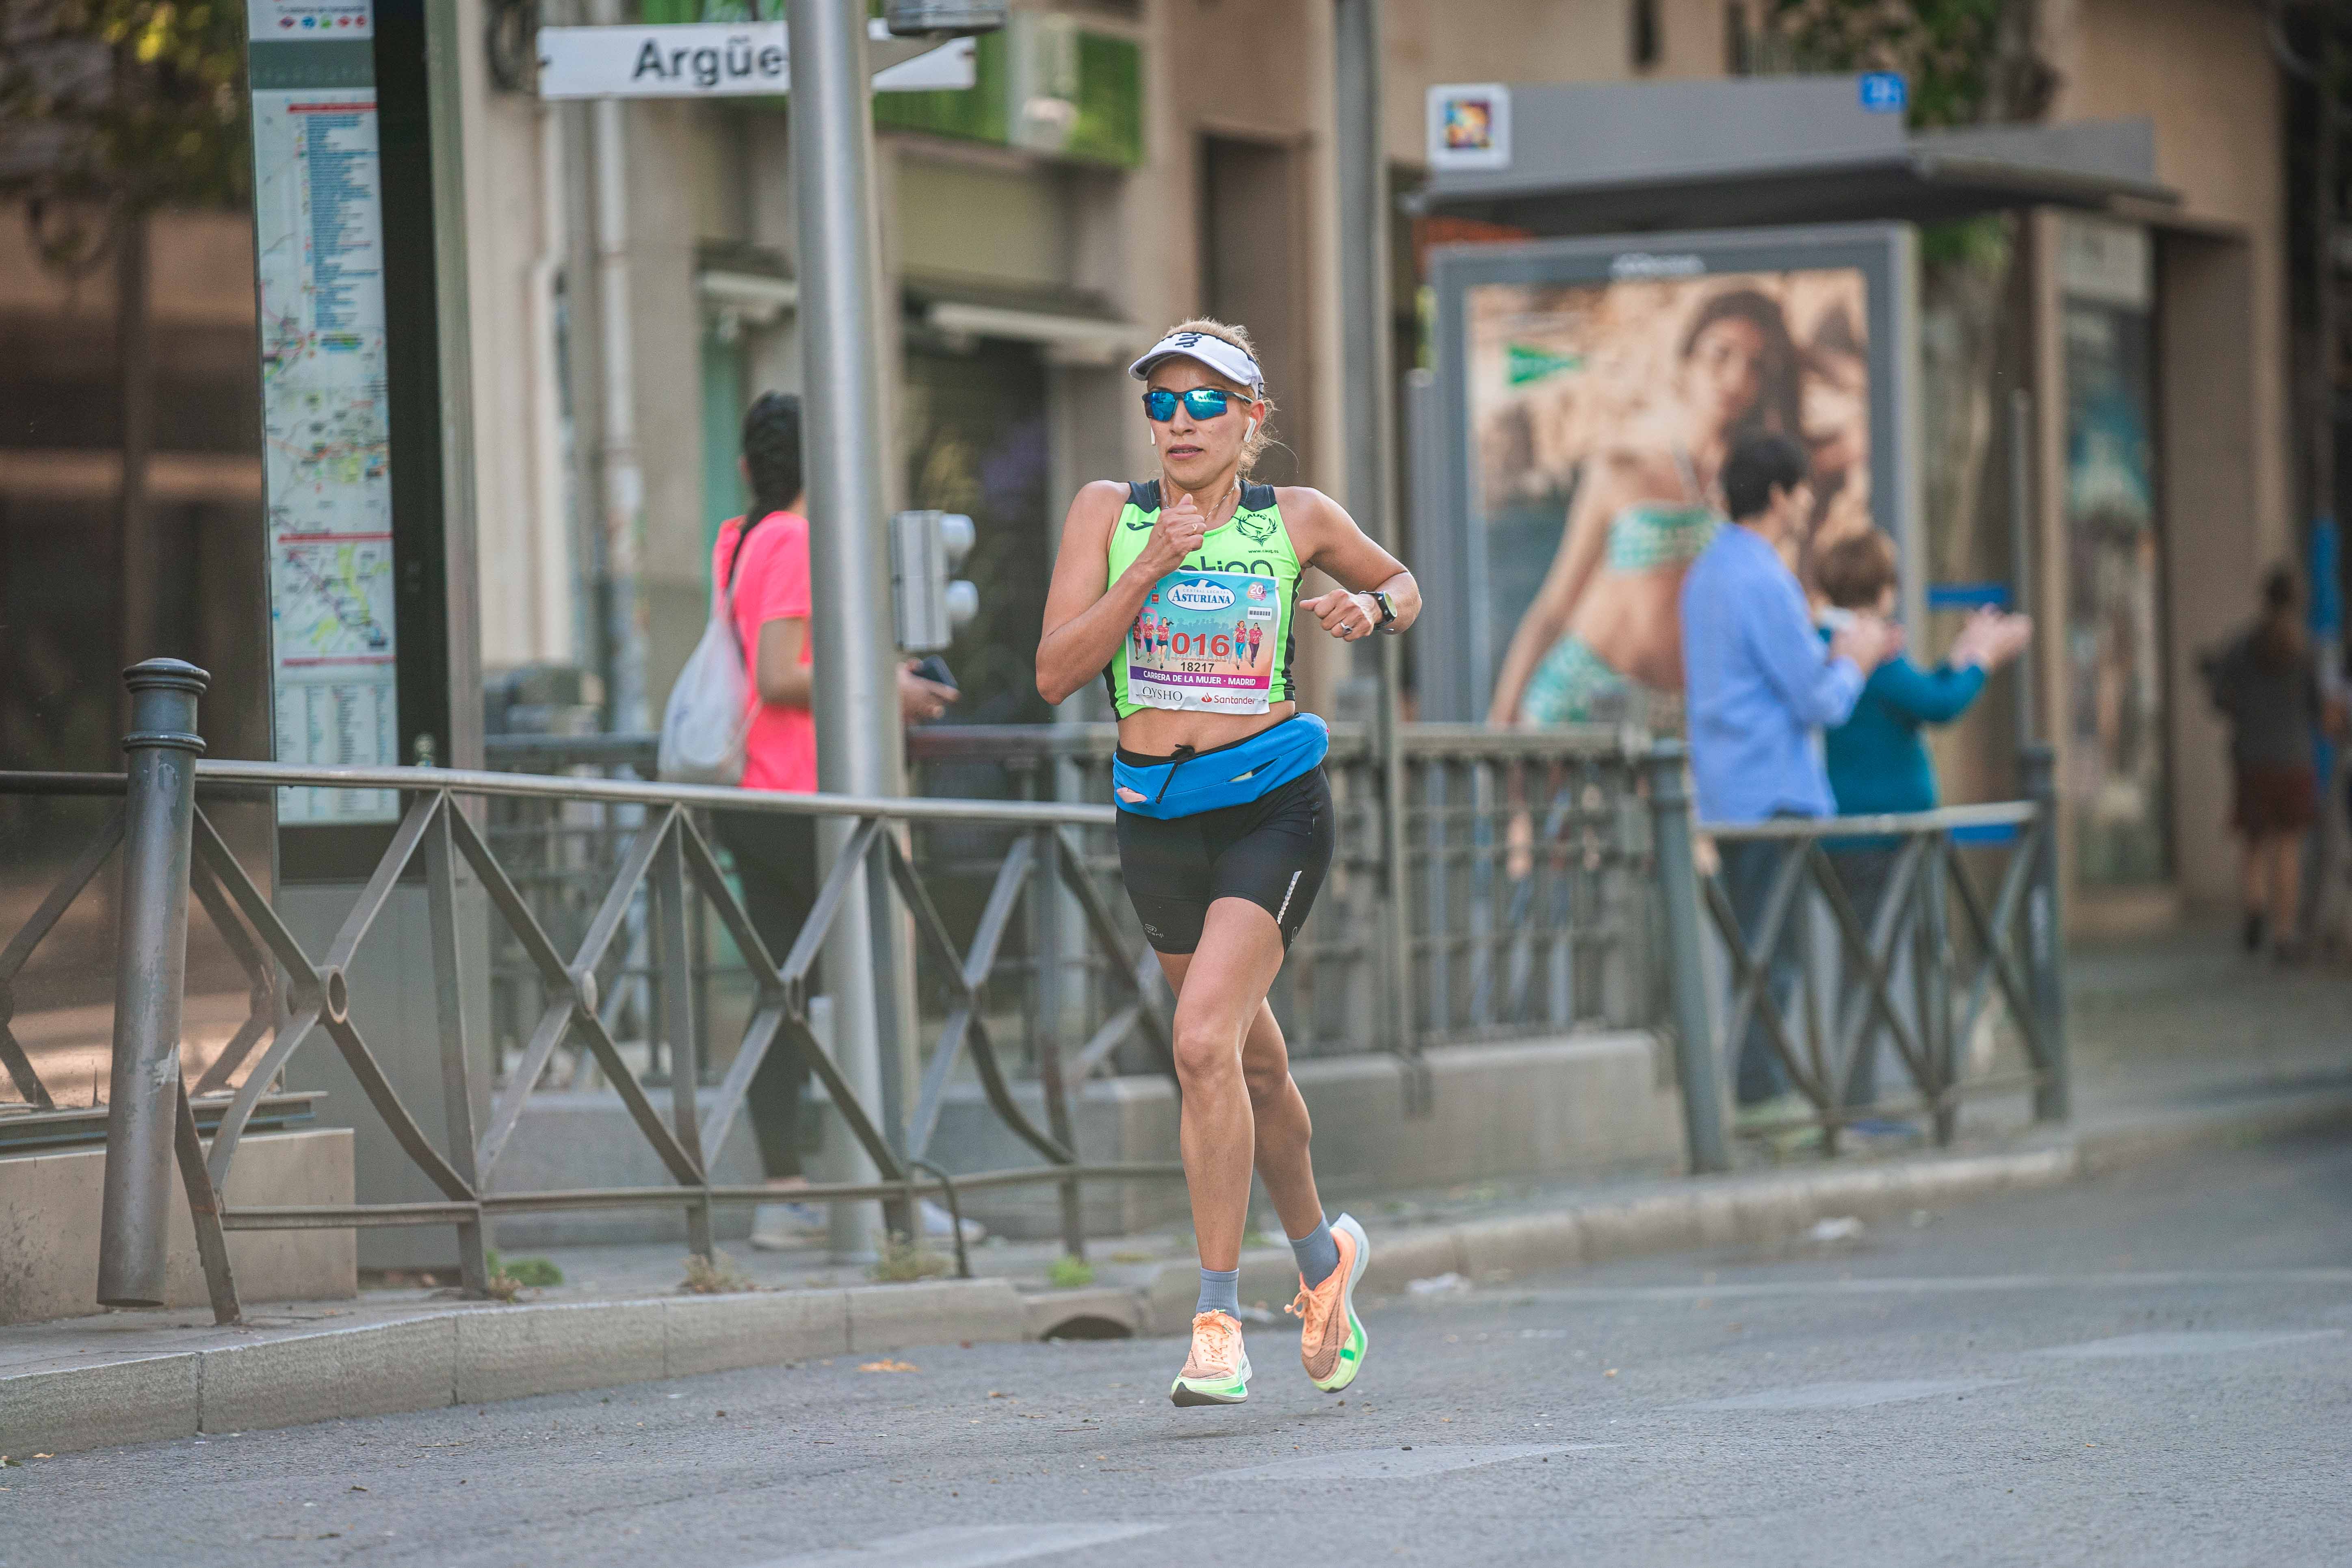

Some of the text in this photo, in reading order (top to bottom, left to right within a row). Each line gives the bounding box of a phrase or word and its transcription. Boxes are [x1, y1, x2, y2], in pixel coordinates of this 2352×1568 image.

[633, 36, 787, 86] Argüe
[1243, 513, 1267, 522] CAUG
[1250, 584, 1263, 594] 20
[1172, 589, 1230, 604] ASTURIANA
[1172, 632, 1230, 656] 016
[1180, 662, 1215, 672] 18217
[1144, 670, 1170, 681] CARRERA
[1143, 687, 1182, 701] OYSHO
[1214, 695, 1254, 704] Santander
